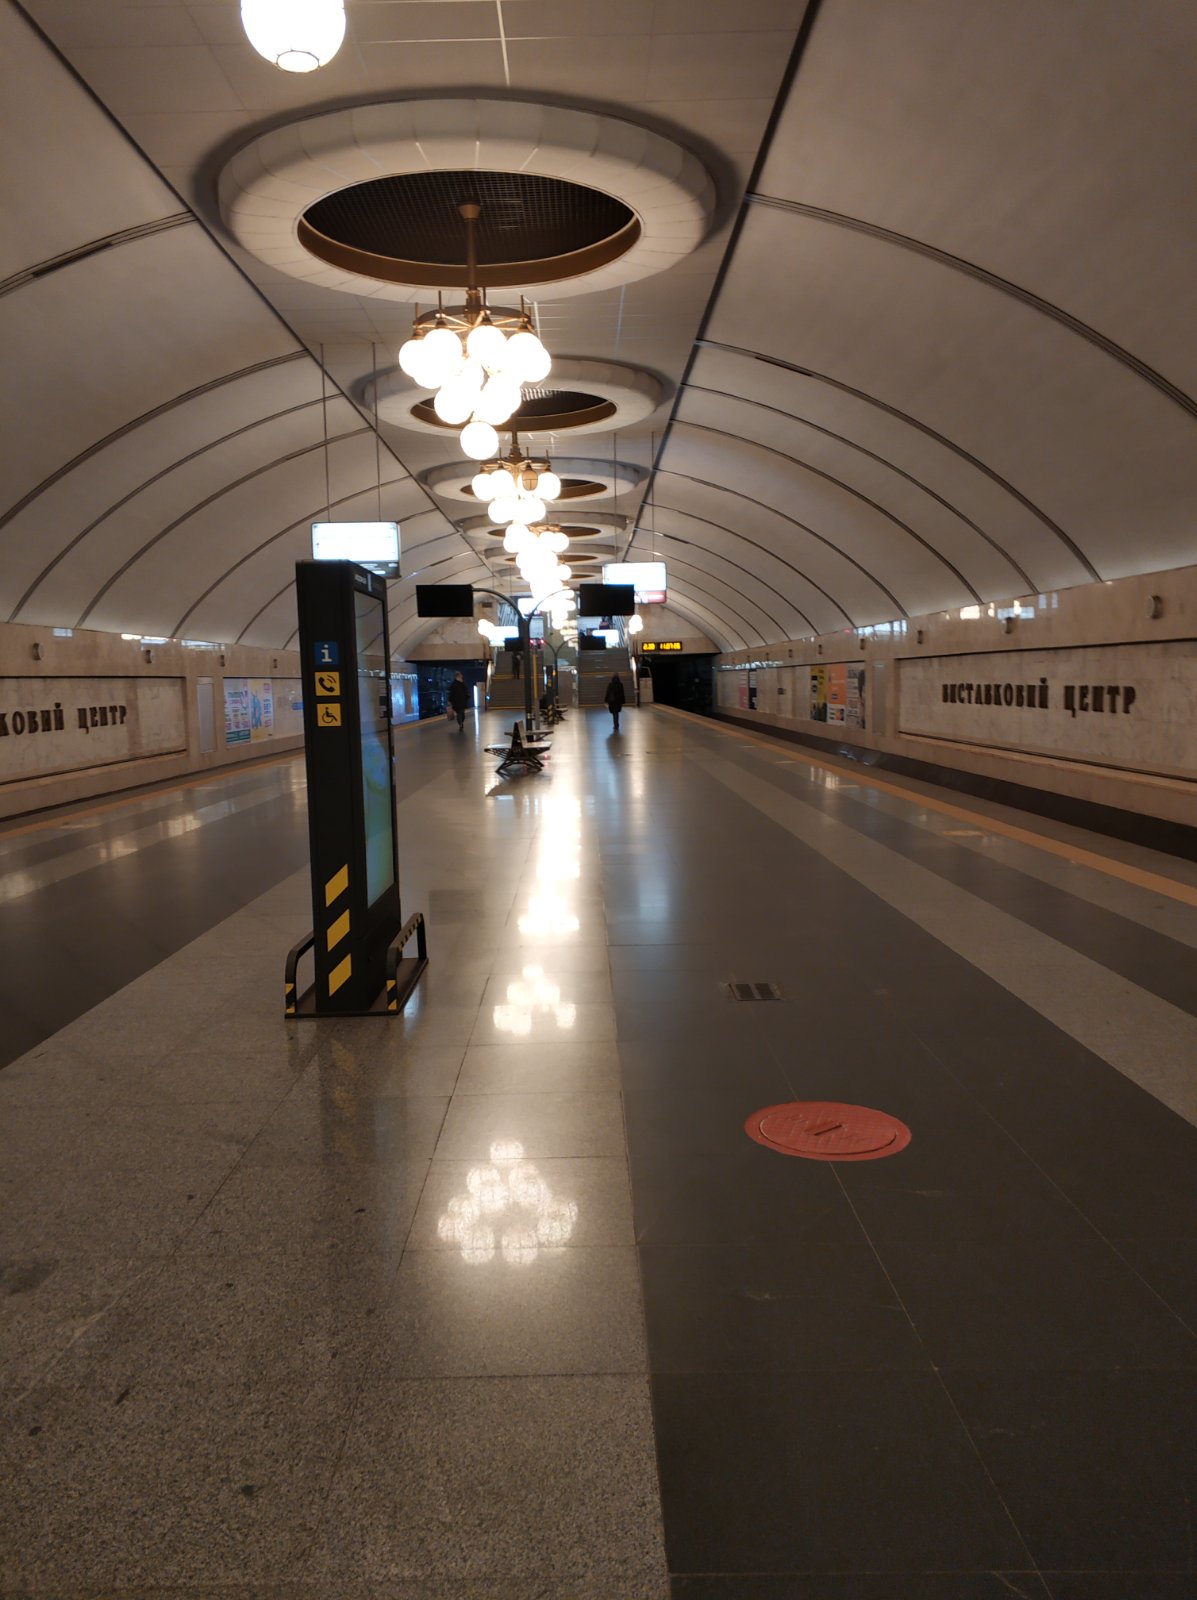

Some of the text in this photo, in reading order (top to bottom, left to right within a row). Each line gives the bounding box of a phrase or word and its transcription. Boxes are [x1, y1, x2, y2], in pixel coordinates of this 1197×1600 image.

[942, 677, 1137, 718] ВИСТАВКОВИЙ ЦЕНТР
[77, 705, 127, 734] ЦЕНТР
